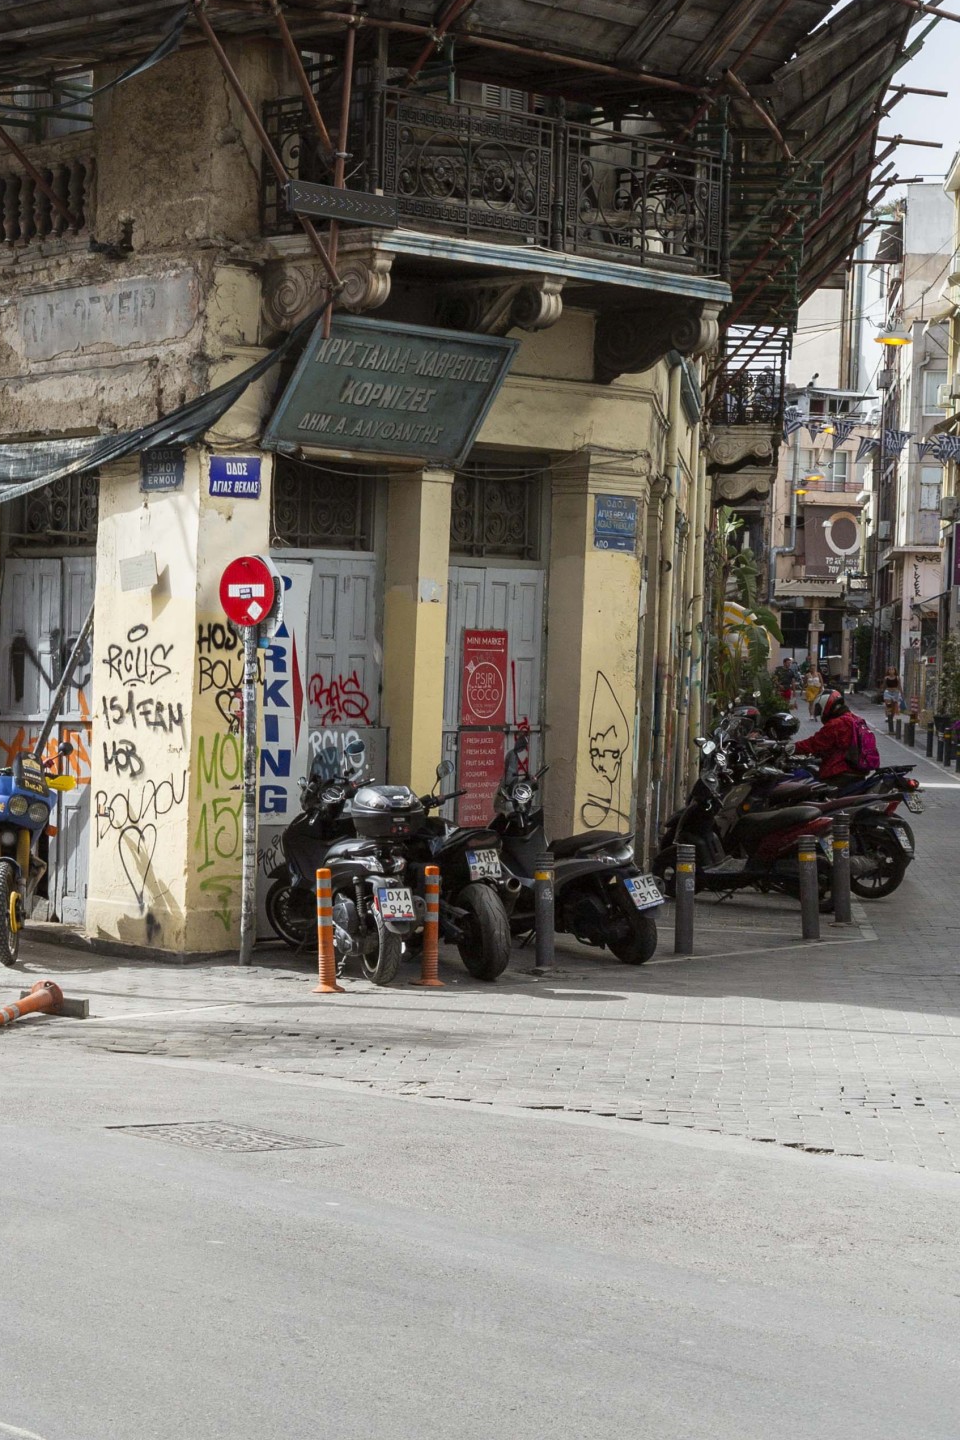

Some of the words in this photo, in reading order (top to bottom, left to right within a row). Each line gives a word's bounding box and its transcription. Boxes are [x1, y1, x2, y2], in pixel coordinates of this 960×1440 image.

[341, 380, 436, 413] ΚΟΡΝΙΖΕΣ
[298, 412, 330, 433] ΔΗΜ.
[226, 462, 248, 476] ΟΔΟΣ
[148, 476, 177, 485] ERMOU
[212, 481, 232, 493] ΑΓΙΑΣ
[234, 481, 259, 494] ΘΕΚΛΑΣ
[466, 637, 481, 645] MINI
[482, 637, 506, 646] MARKET
[475, 672, 496, 685] PSIRI
[470, 688, 500, 701] COCO
[475, 851, 497, 863] XHP
[633, 876, 655, 890] OYE
[387, 891, 411, 901] OXA
[639, 889, 660, 902] 519
[390, 904, 413, 915] 942
